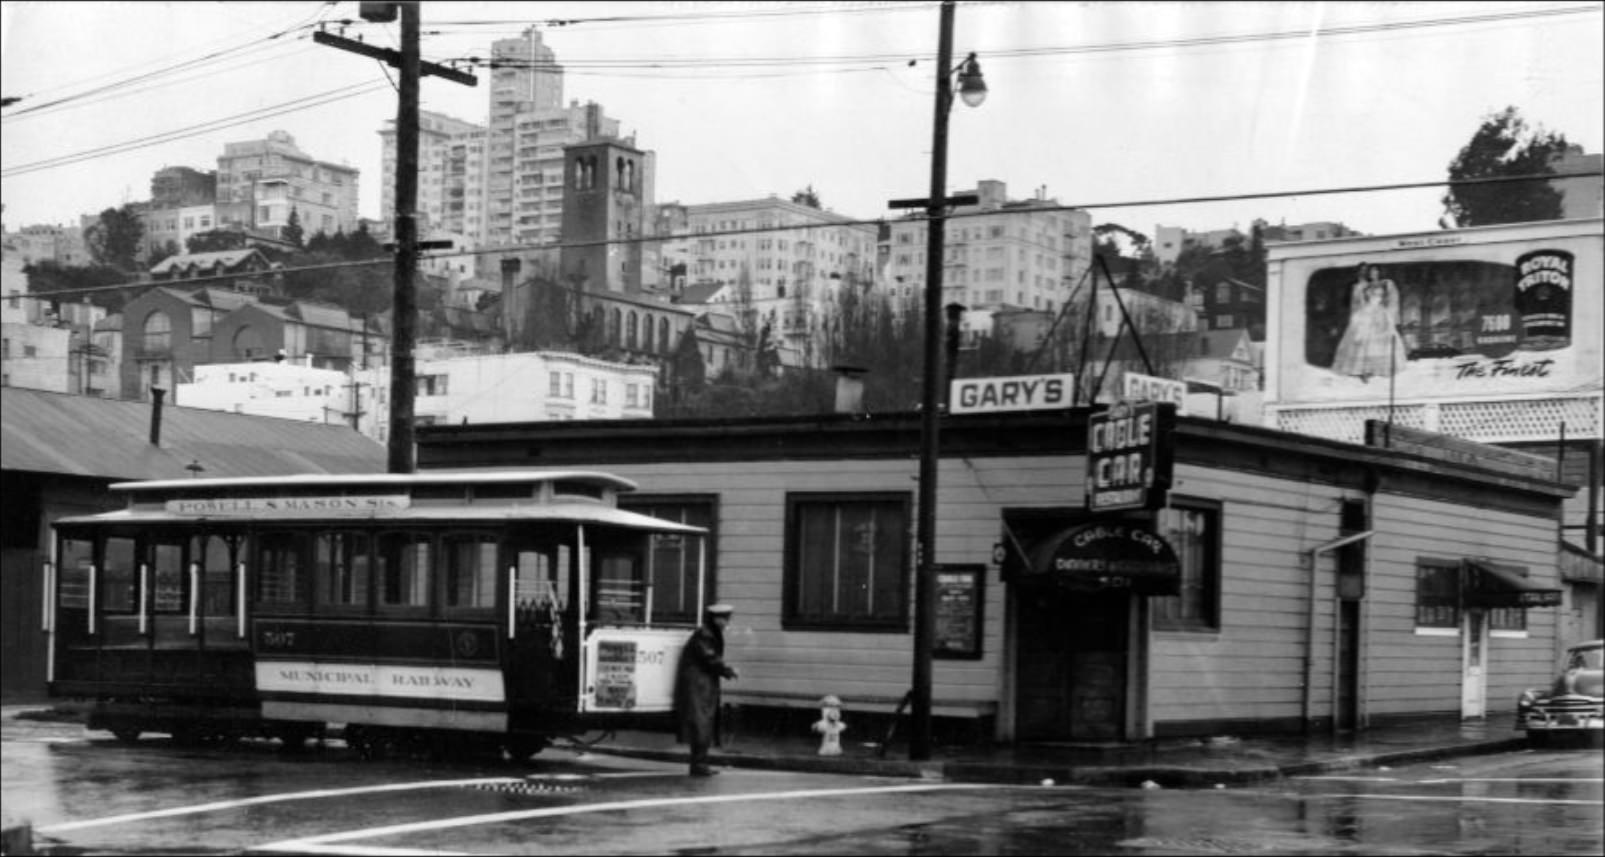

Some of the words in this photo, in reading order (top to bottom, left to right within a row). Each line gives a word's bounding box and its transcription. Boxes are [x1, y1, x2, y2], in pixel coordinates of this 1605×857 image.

[1520, 255, 1568, 276] ROYAL
[1518, 269, 1571, 291] TRITON
[1456, 361, 1486, 380] The
[1491, 358, 1556, 378] Finest
[960, 378, 1064, 408] GARY'S
[1130, 377, 1183, 403] GARY'S
[1093, 413, 1152, 453] CABLE
[1097, 452, 1142, 488] CAR
[178, 500, 257, 513] POWELL
[284, 499, 358, 511] MASON
[1073, 526, 1124, 548] CABLE
[1130, 528, 1163, 555] CAR
[263, 630, 295, 647] 507
[637, 649, 665, 665] 507
[279, 669, 375, 684] MUNICIPAL
[391, 673, 475, 689] RAILWAY
